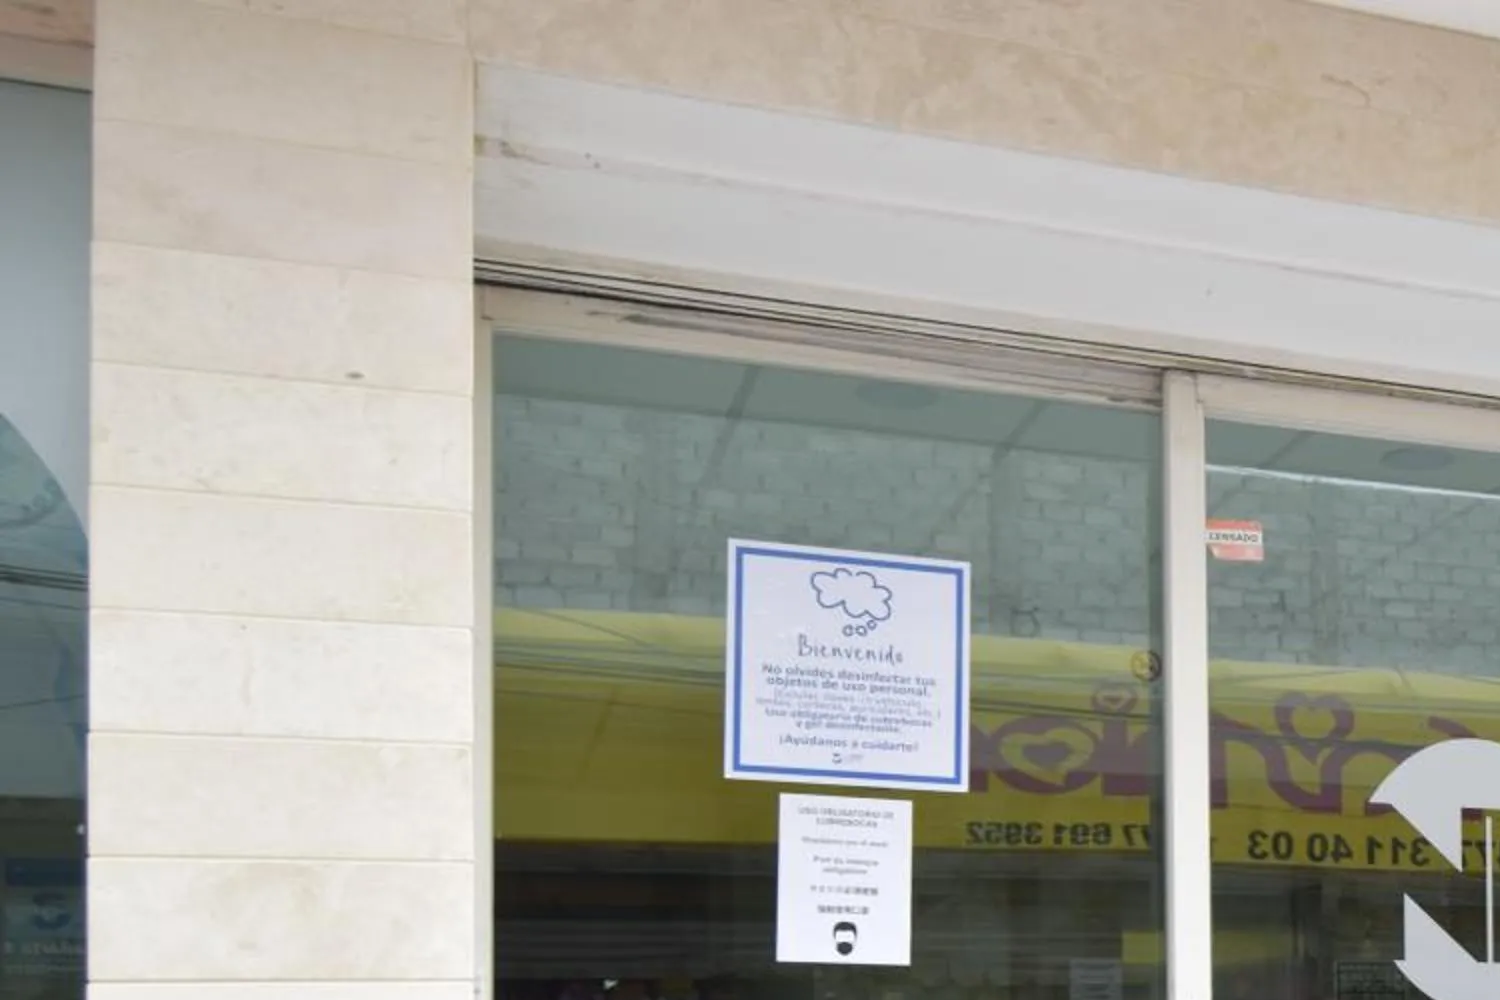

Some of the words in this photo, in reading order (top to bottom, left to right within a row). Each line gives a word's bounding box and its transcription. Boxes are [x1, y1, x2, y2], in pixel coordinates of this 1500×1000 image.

[761, 663, 782, 675] No
[785, 665, 834, 680] olvides
[766, 676, 817, 691] objetos
[821, 680, 839, 690] de
[842, 682, 867, 693] uso
